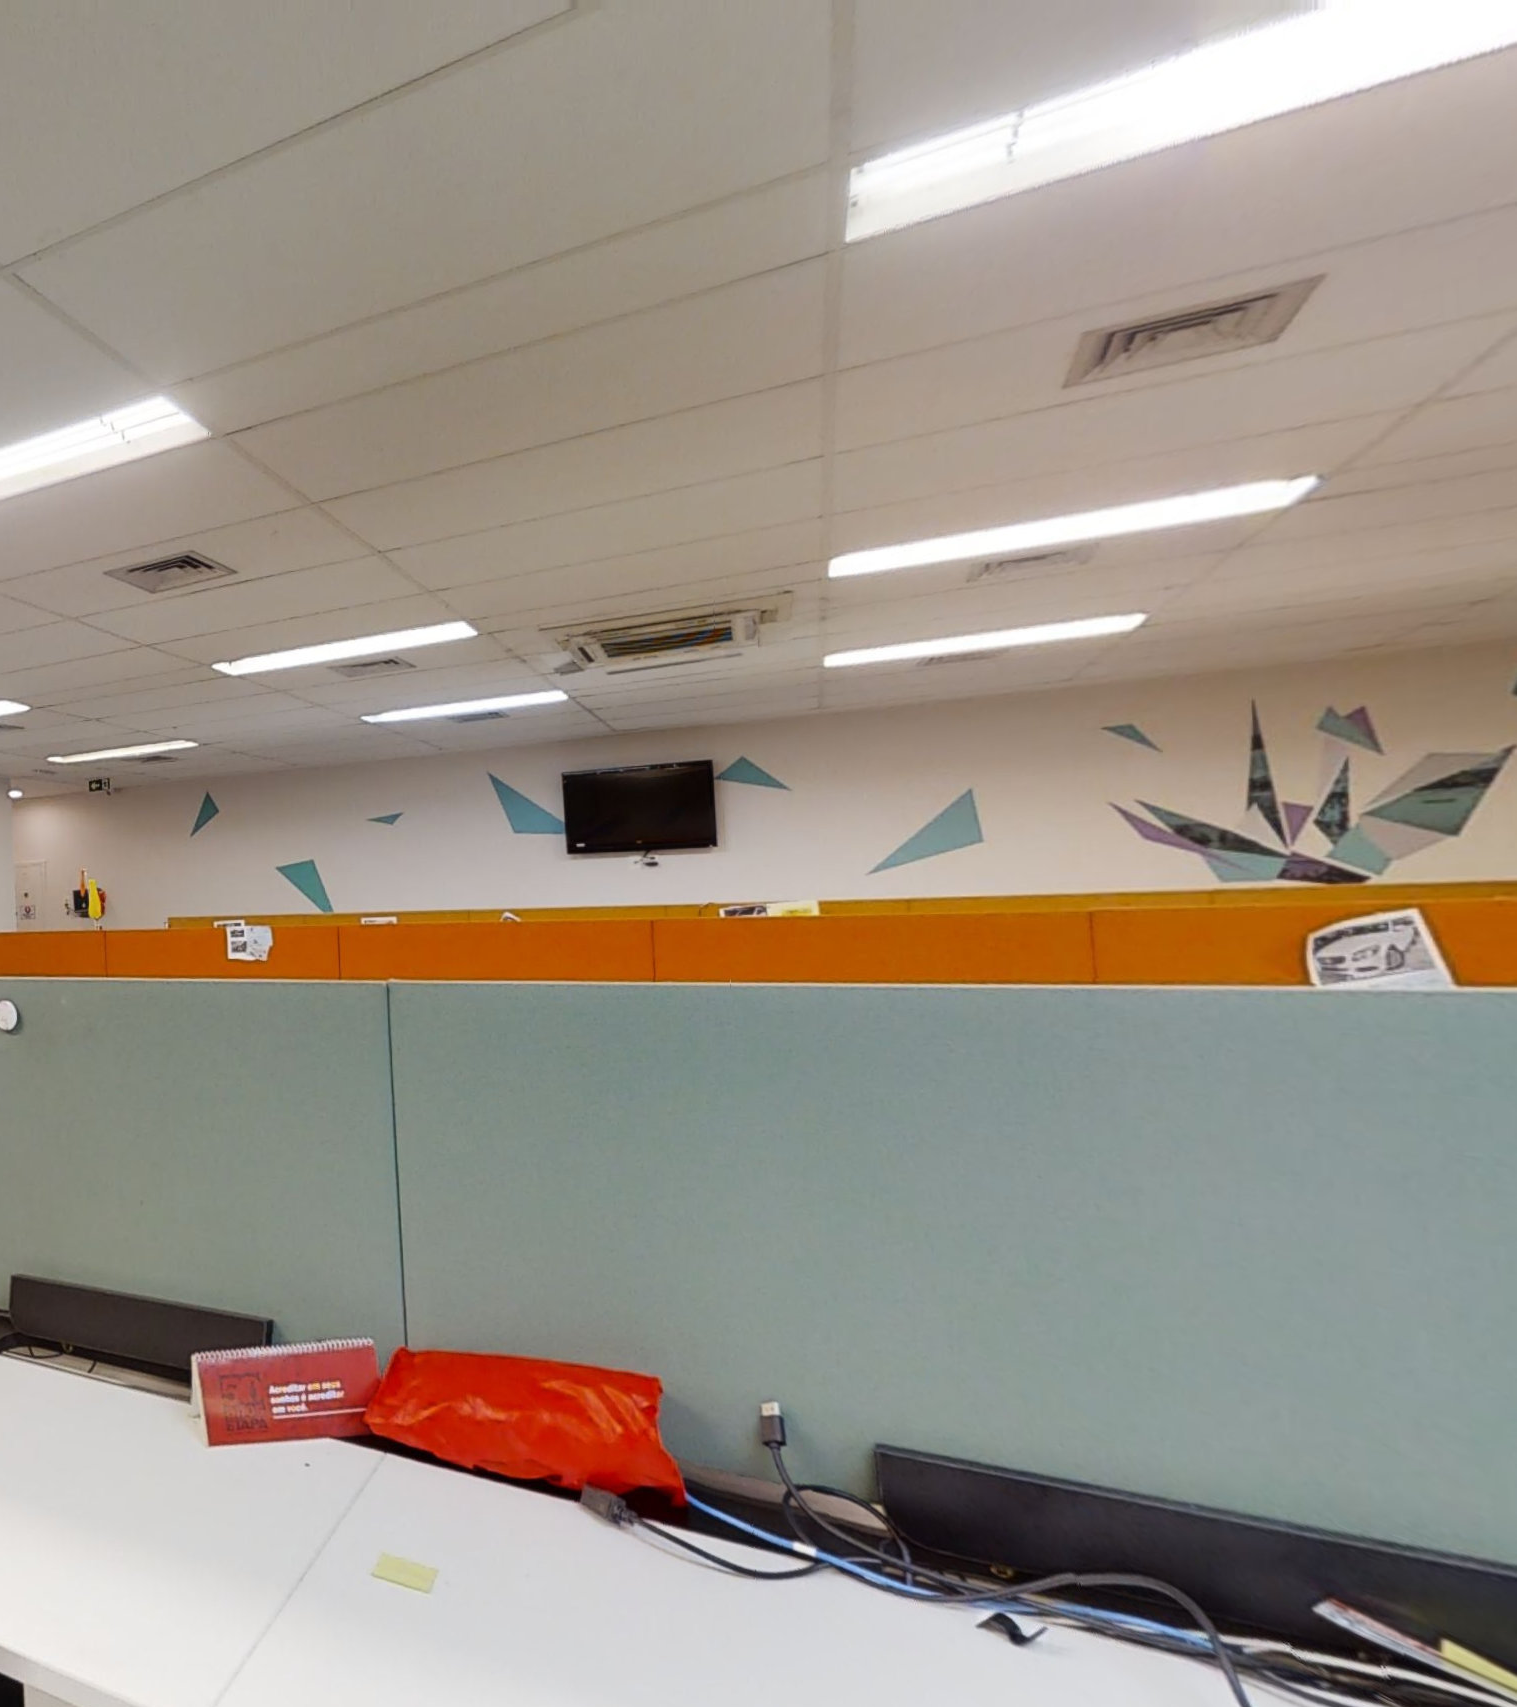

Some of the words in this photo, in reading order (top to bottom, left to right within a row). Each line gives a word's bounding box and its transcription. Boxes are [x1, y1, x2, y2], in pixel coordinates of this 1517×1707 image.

[269, 1384, 306, 1395] Acreditar
[307, 1383, 321, 1391] em
[308, 1390, 345, 1401] acreditar
[272, 1406, 286, 1414] em
